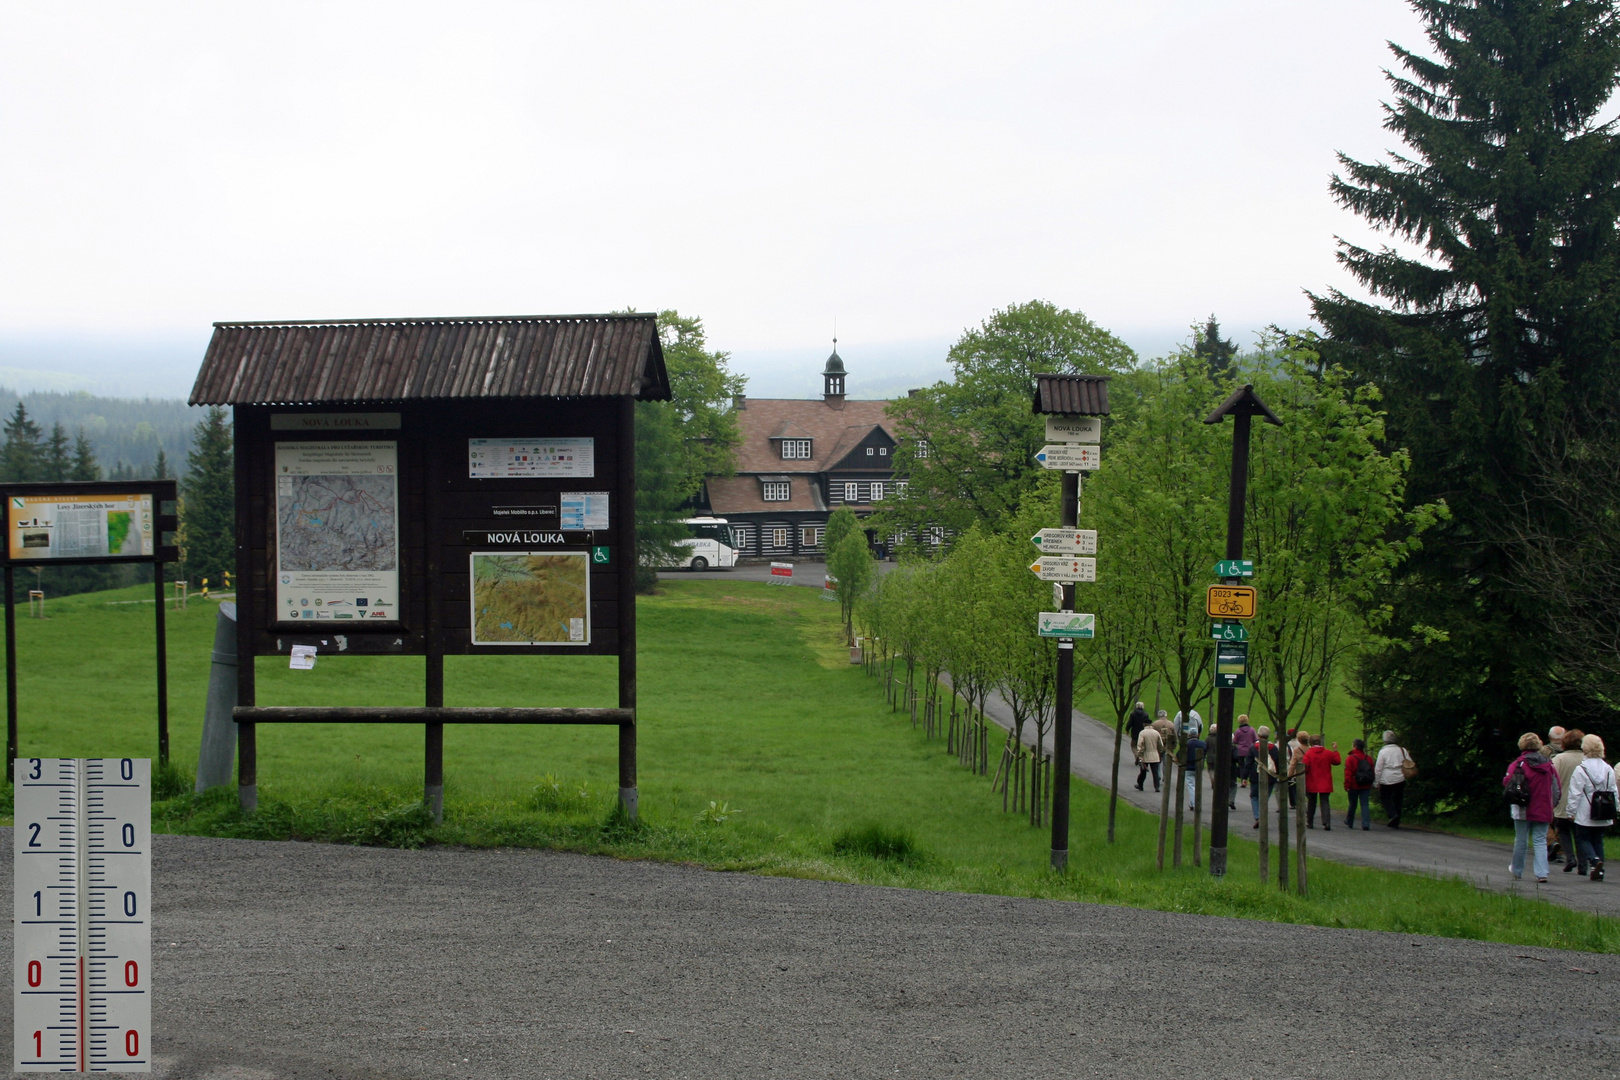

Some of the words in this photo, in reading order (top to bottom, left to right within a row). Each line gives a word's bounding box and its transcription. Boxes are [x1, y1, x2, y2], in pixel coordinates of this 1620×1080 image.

[302, 417, 329, 427] NOVÁ
[334, 418, 369, 426] LOUKA
[127, 496, 135, 509] 5
[487, 531, 521, 544] NOVÁ
[524, 533, 565, 544] LOUKA
[1219, 563, 1224, 574] 1
[1213, 590, 1232, 598] 3023
[1239, 628, 1243, 639] 1
